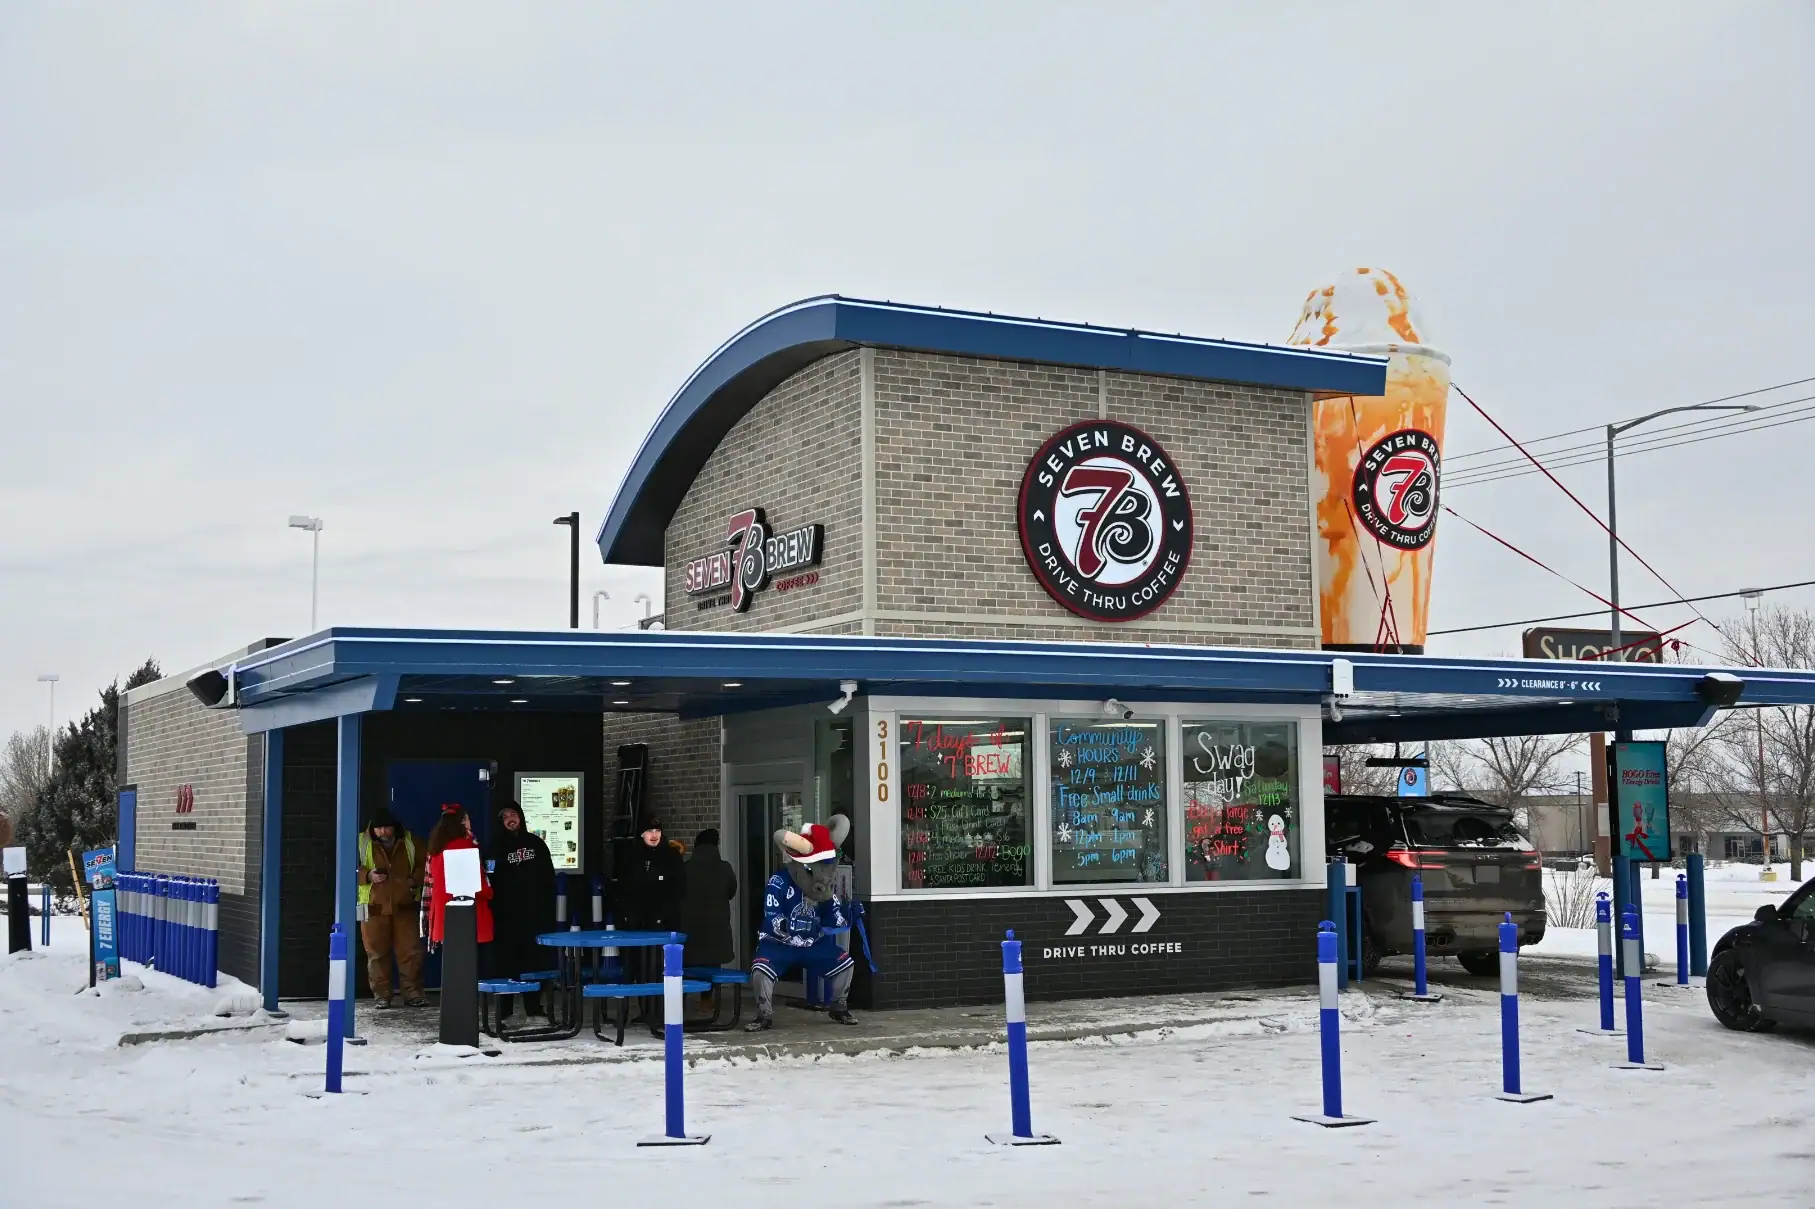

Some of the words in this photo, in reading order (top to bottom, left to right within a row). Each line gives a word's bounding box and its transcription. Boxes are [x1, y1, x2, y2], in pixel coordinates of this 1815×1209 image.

[1038, 430, 1109, 488] SEVEN
[1121, 435, 1181, 499] BREW
[1365, 435, 1416, 472] SEVEN
[1361, 503, 1389, 536] DRIVE
[1390, 530, 1417, 545] THRU
[685, 551, 731, 594] SEVEN
[766, 525, 816, 573] BREW
[1038, 543, 1079, 595] DRIVE
[1082, 588, 1126, 610] THRU
[1131, 550, 1181, 606] COFFEE
[1521, 679, 1559, 689] CLEARANCE
[906, 721, 923, 752] 7
[1057, 723, 1145, 754] Community
[877, 719, 889, 803] 3100
[943, 755, 957, 779] 7
[964, 752, 1012, 777] BREW
[1077, 747, 1120, 764] HOURS
[1192, 731, 1256, 780] Swag
[1070, 767, 1097, 785] 12/9
[1113, 764, 1138, 783] 12/11
[1206, 771, 1243, 803] day!
[1622, 769, 1645, 779] BOGO
[1058, 783, 1089, 809] Free
[1091, 784, 1125, 806] Small
[1258, 793, 1282, 806] 12/13
[1072, 810, 1099, 827] 8am
[1111, 807, 1136, 823] 9am
[1225, 819, 1244, 836] free
[1077, 851, 1100, 868] 5pm
[1112, 848, 1137, 865] 6pm
[1213, 840, 1240, 857] Shirt
[97, 899, 113, 940] ENERGY
[1043, 946, 1086, 959] DRIVE
[1090, 944, 1126, 957] THRU
[1130, 942, 1182, 955] COFFEE
